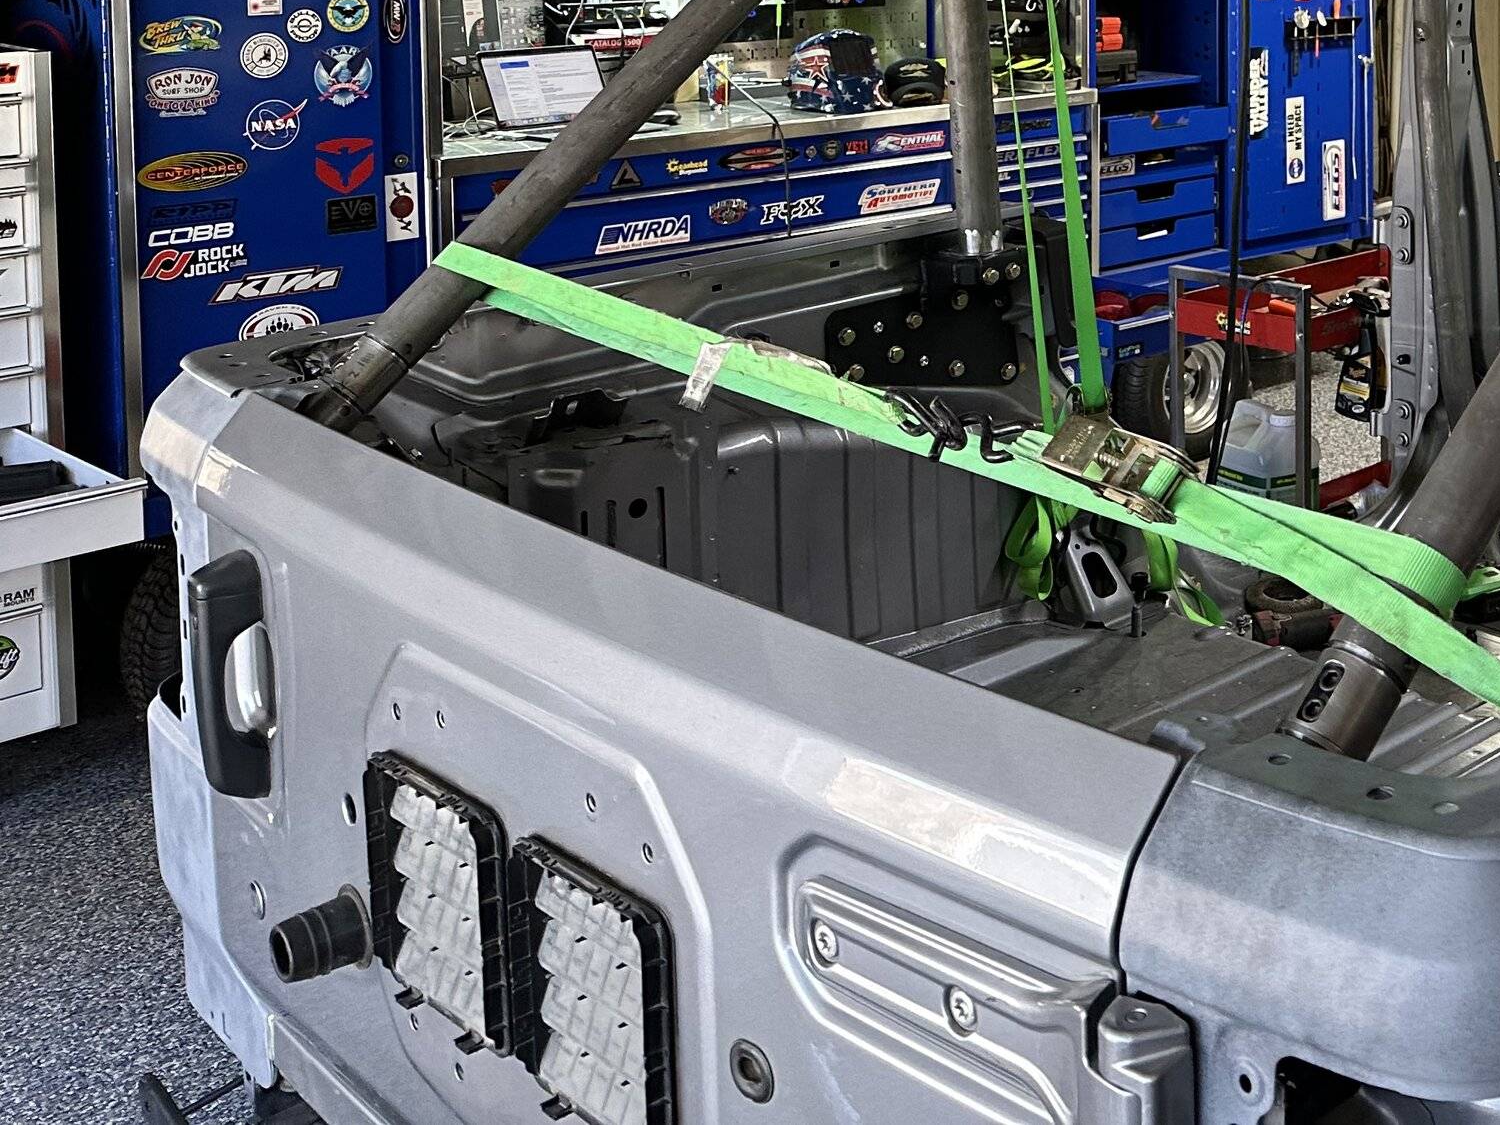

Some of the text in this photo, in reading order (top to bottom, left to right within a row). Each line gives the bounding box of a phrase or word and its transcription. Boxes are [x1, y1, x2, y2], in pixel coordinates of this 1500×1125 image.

[289, 10, 321, 24] BULLET
[289, 28, 321, 42] PROOF
[154, 74, 213, 90] RON JON
[250, 118, 297, 132] NASA
[147, 163, 244, 180] CENTERFORCE
[866, 182, 936, 200] SOUTHERN
[866, 190, 934, 209] AUTOMOTIVE
[148, 222, 235, 247] COBB
[616, 217, 689, 243] NHRDA
[198, 244, 245, 261] ROCK
[183, 259, 230, 278] JOCK
[215, 267, 341, 303] KTM
[3, 588, 35, 601] RAM
[4, 597, 35, 607] MOUNTS
